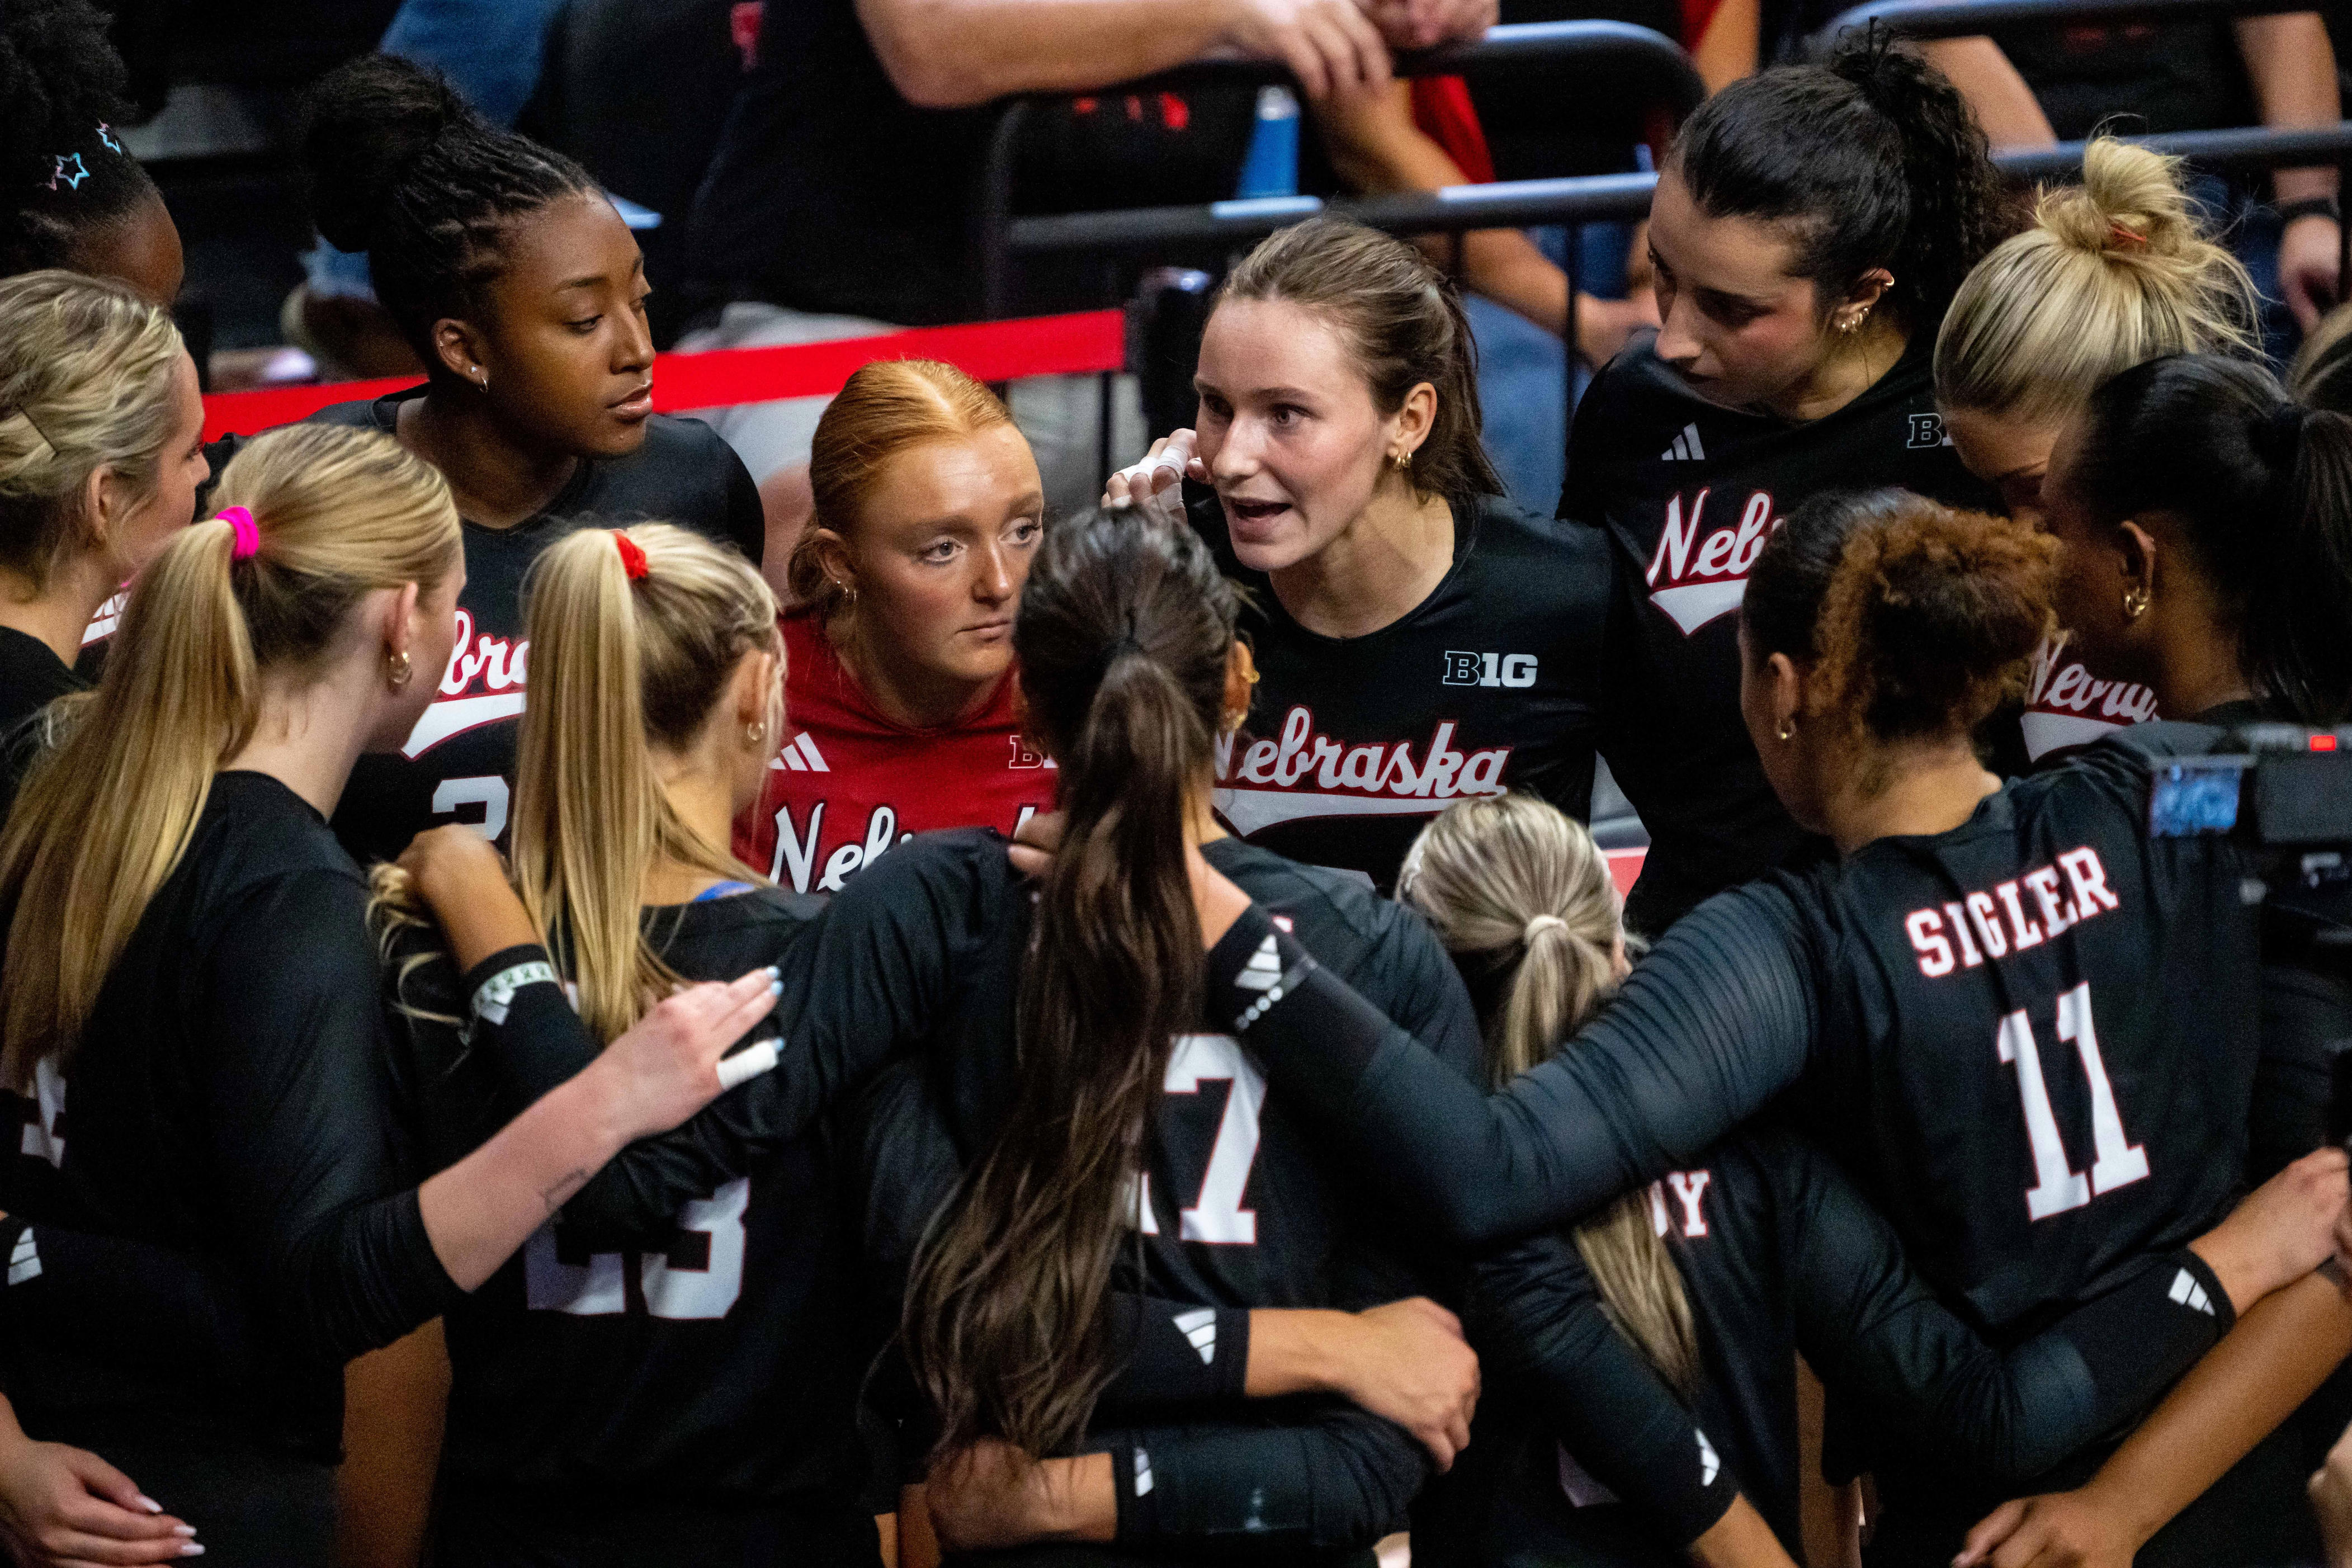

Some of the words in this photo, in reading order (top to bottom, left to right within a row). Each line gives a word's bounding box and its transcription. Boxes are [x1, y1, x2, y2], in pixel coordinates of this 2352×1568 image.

[1906, 413, 1953, 448] B
[1646, 488, 1785, 588] Neb
[1442, 650, 1538, 688] B1G
[1905, 845, 2119, 978] SIGLER
[1132, 1033, 1268, 1245] 7
[1997, 980, 2150, 1221] 11
